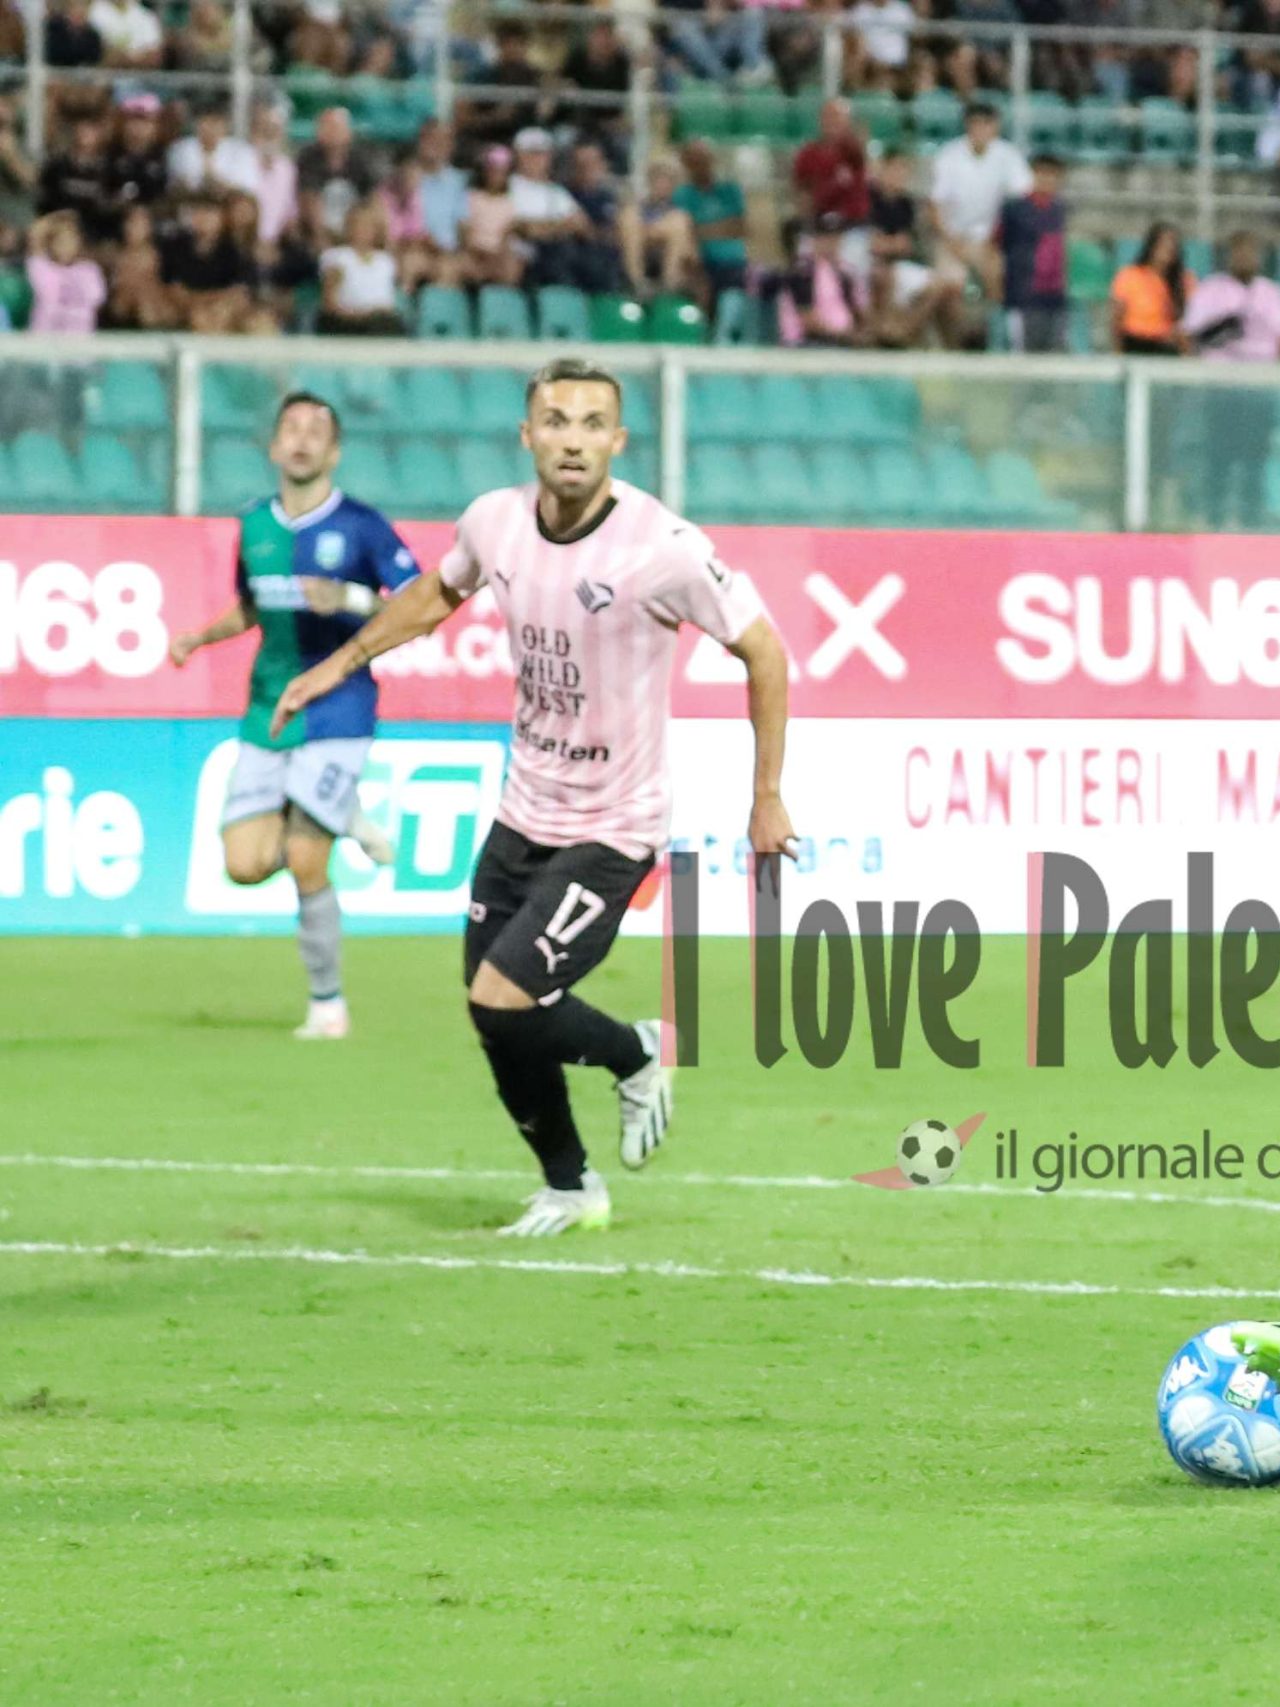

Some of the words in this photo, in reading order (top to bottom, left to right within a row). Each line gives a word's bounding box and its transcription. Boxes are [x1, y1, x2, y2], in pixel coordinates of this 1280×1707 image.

[521, 624, 571, 657] OLD
[904, 746, 1162, 828] CANTIERI
[545, 882, 606, 945] 17
